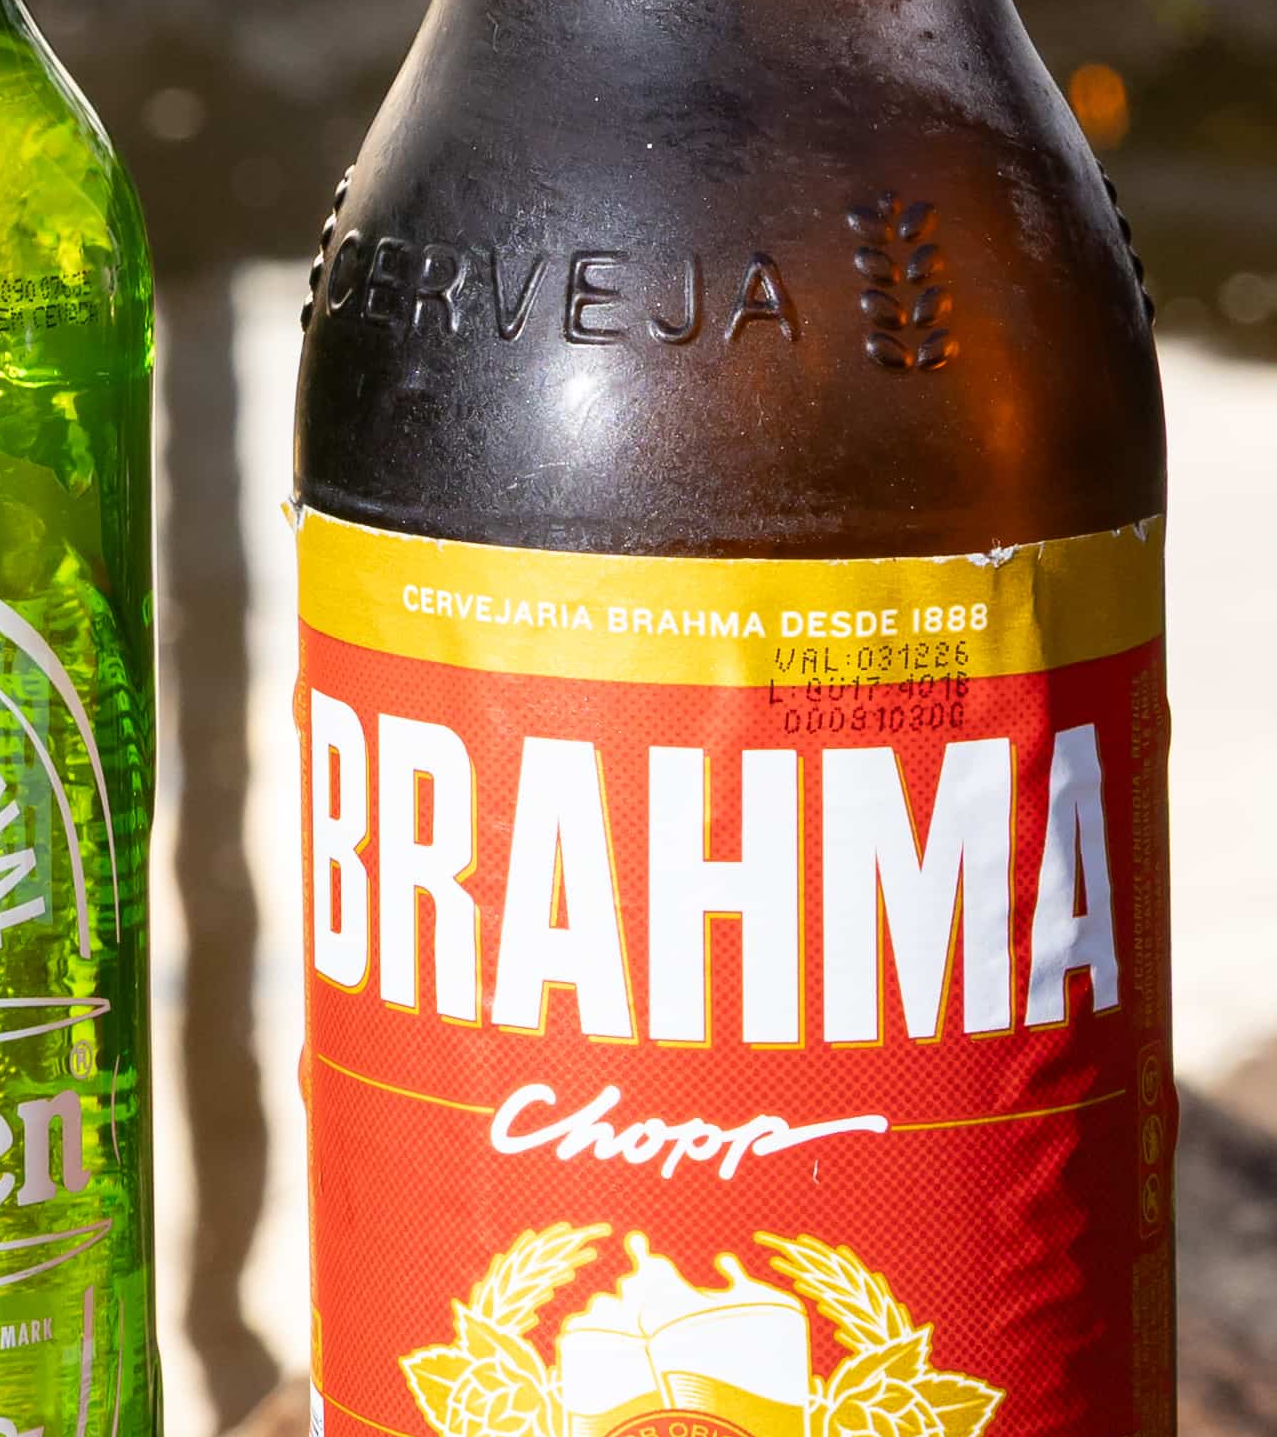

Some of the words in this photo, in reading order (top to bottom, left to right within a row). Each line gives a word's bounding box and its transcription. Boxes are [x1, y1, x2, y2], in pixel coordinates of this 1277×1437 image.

[325, 227, 802, 347] CERVEJA
[402, 584, 593, 631] CERVEJARIA
[608, 607, 766, 640] BRAHMA
[782, 607, 898, 639] DESDE
[912, 604, 989, 633] 1888
[309, 686, 1122, 1050] BRAHMA
[489, 1083, 889, 1181] Chopp
